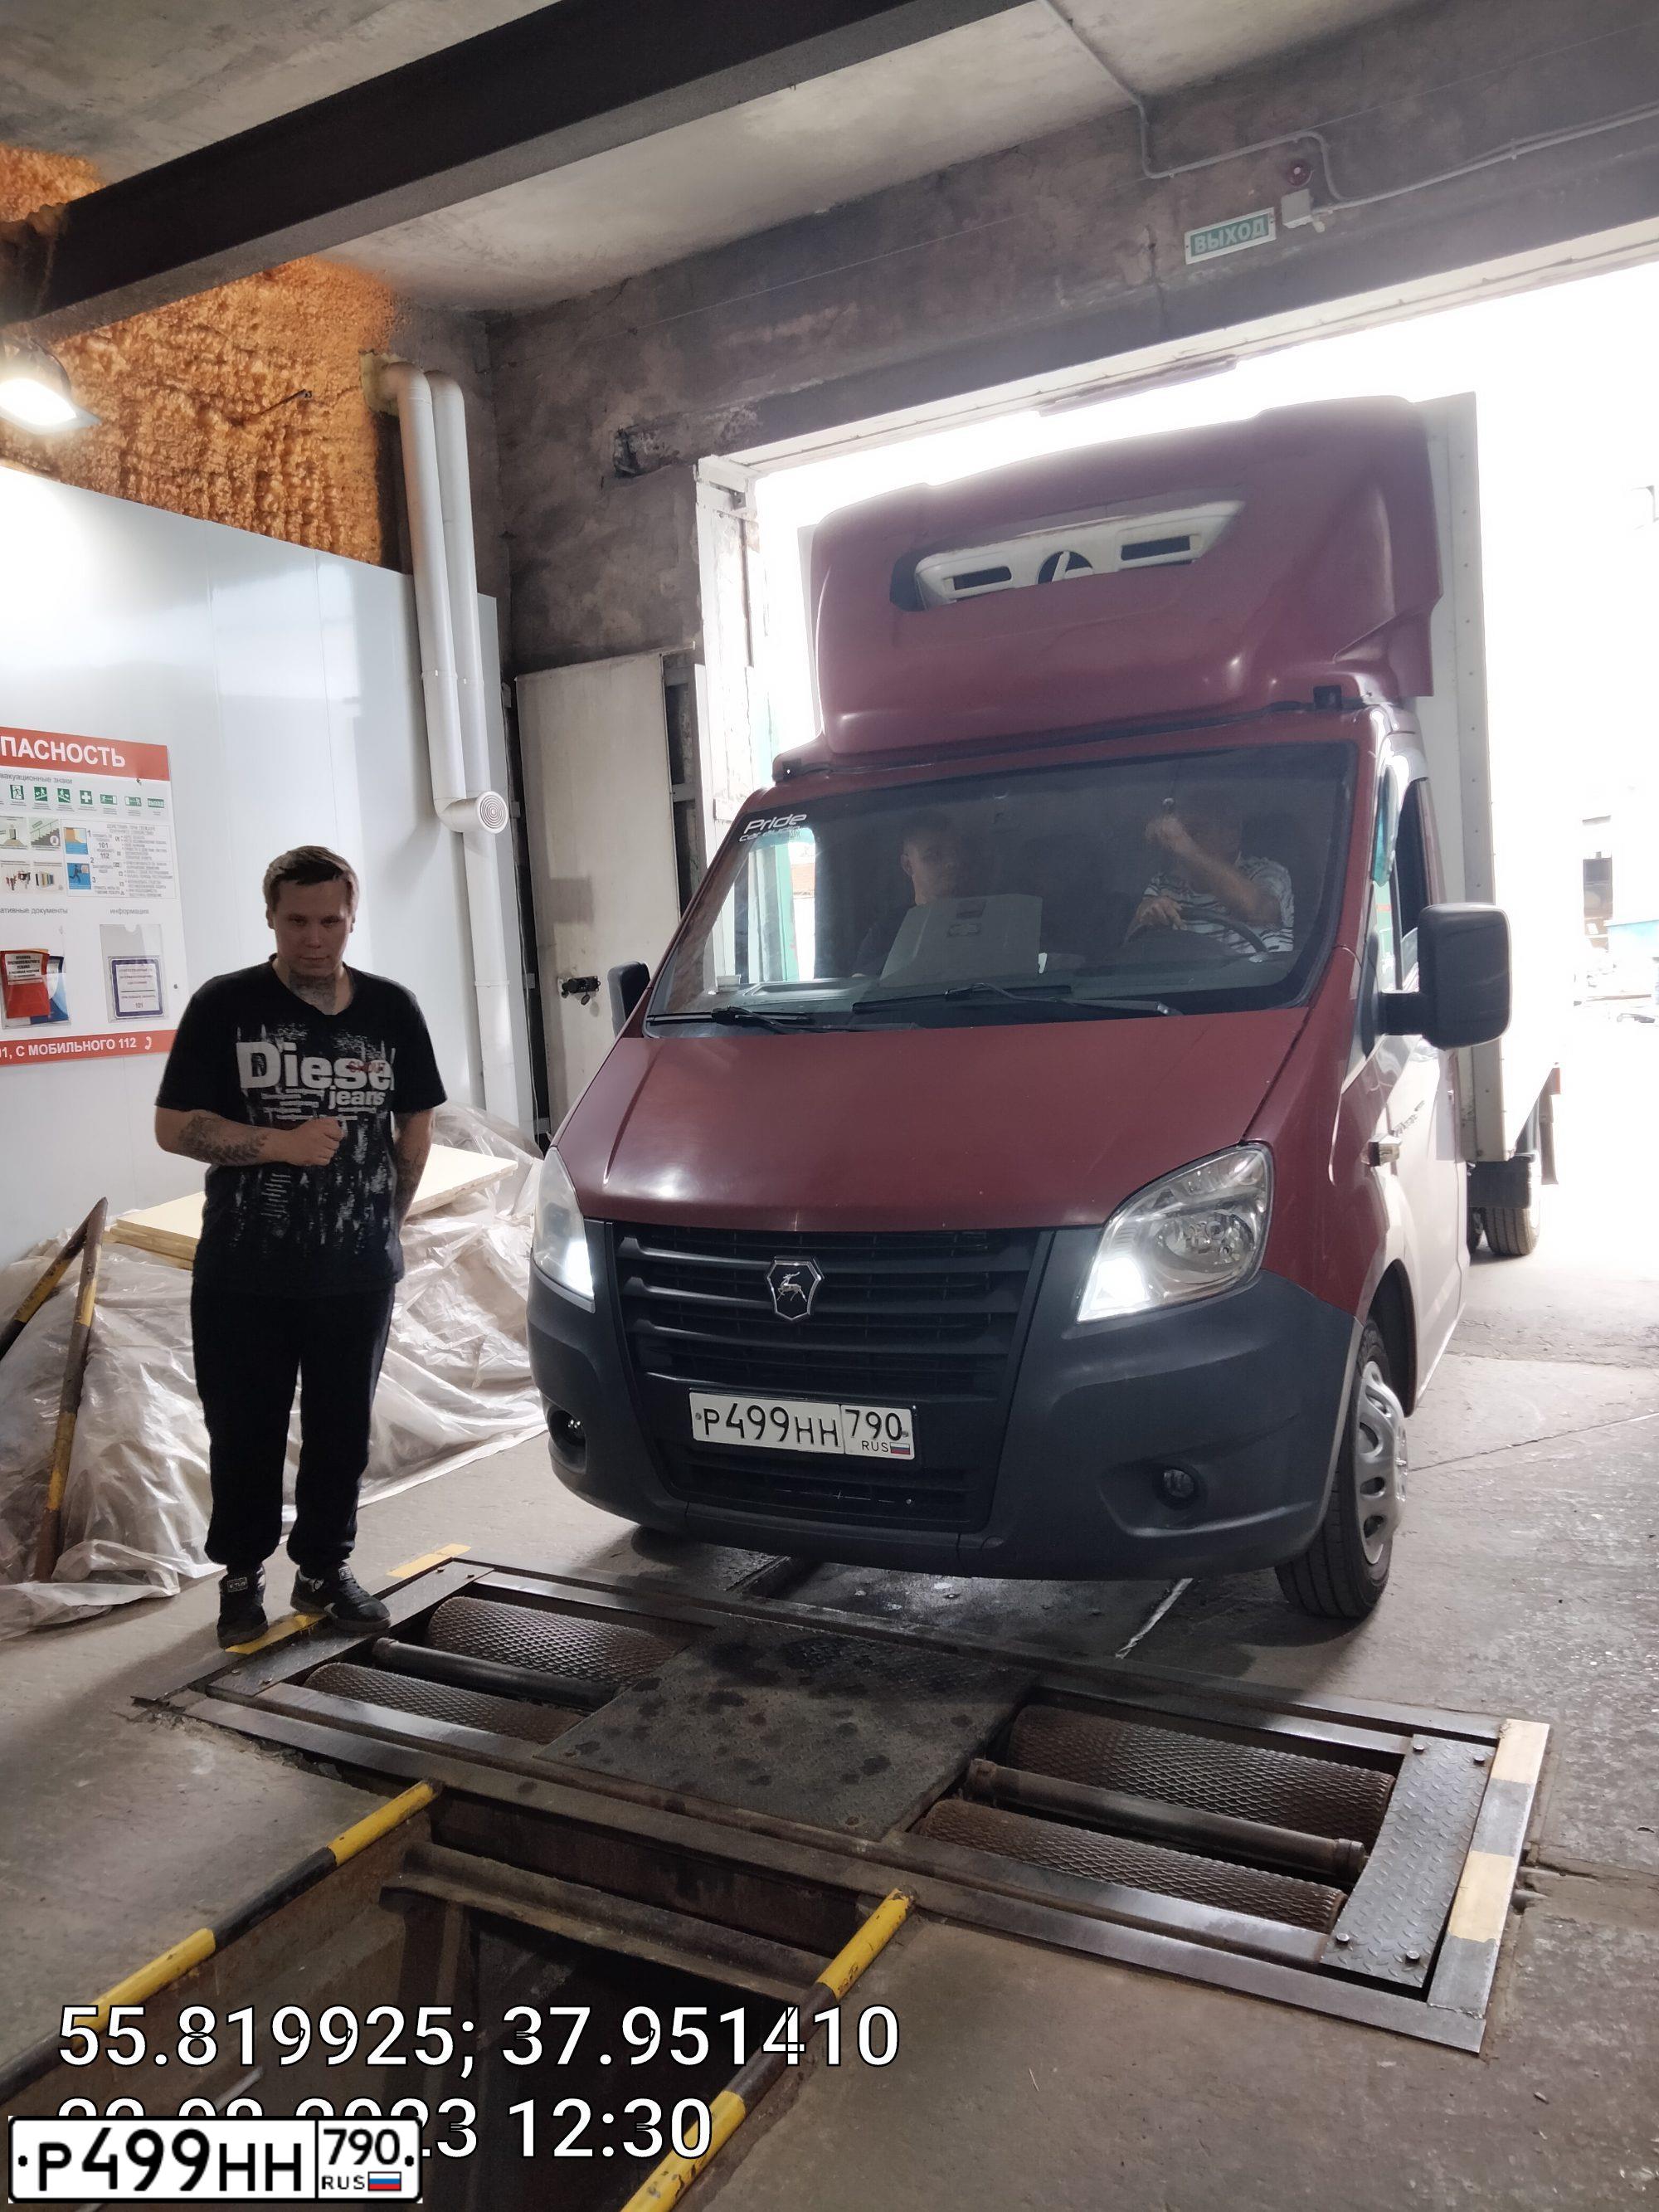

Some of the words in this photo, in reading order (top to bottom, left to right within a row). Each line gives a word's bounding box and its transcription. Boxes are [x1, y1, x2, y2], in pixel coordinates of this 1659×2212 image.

[1194, 218, 1267, 254] ВЫХОД
[0, 736, 125, 767] ПАСНОСТЬ
[743, 813, 807, 834] Pride
[0, 1046, 12, 1060] 1,
[16, 1045, 25, 1057] С
[28, 1038, 115, 1056] МОБИЛЬНОГО
[118, 1037, 137, 1049] 112
[328, 1085, 387, 1110] jeans
[844, 1409, 903, 1441] 790
[861, 1440, 889, 1453] RUS
